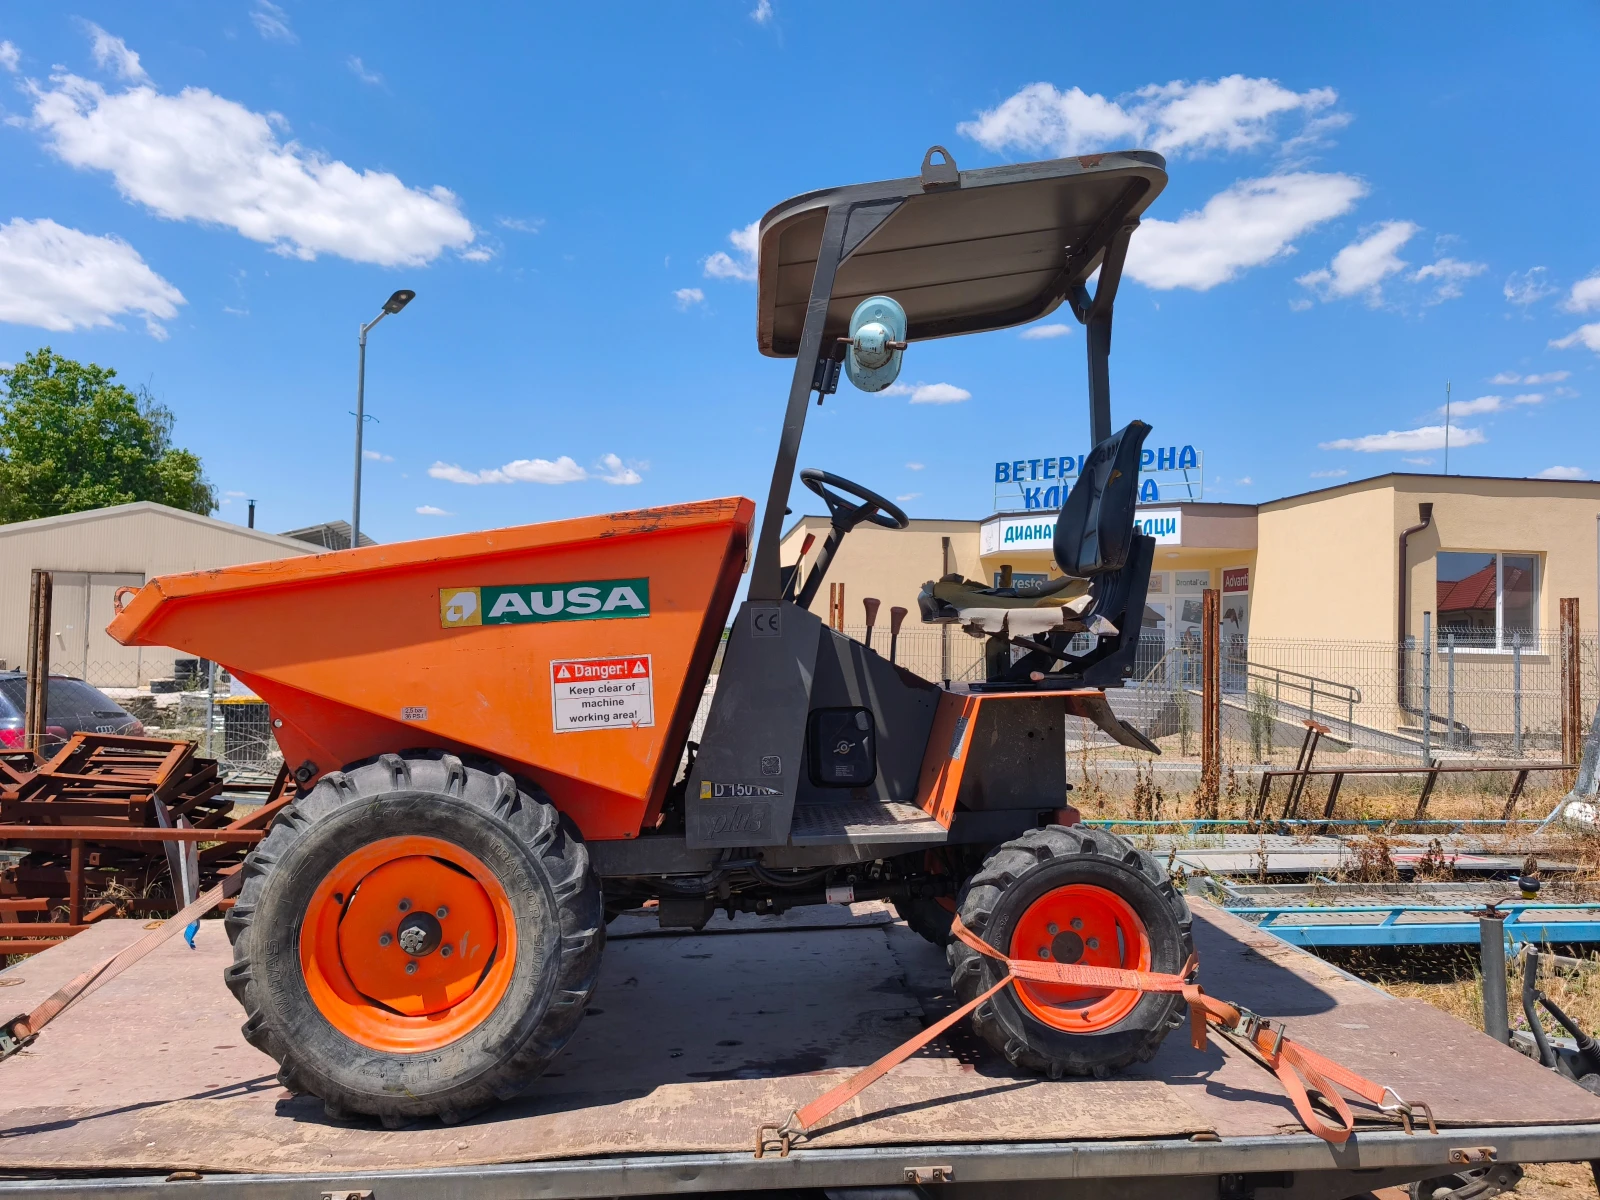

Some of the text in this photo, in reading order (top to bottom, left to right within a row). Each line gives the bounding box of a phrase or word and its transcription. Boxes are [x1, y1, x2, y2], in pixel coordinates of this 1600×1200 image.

[995, 445, 1197, 483] ВЕТЕРРНА
[1004, 523, 1058, 543] ДИАНА
[488, 586, 646, 618] AUSA
[755, 613, 778, 632] CE
[569, 682, 636, 696] Keep clear of
[581, 698, 625, 708] machine
[569, 710, 638, 723] working area!
[714, 783, 725, 797] D
[728, 783, 753, 797] 150
